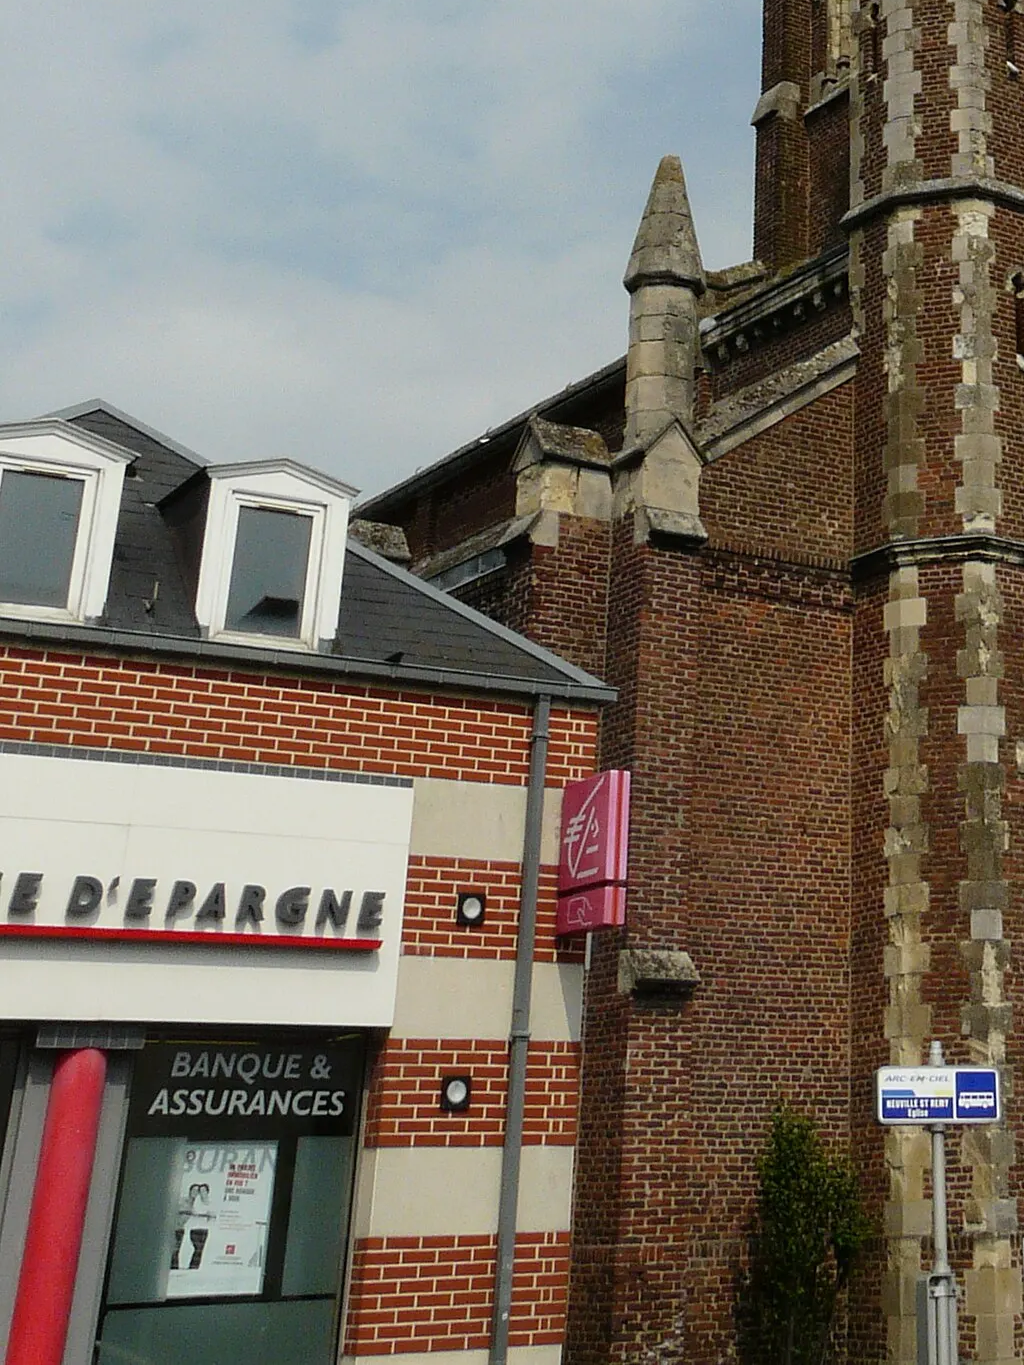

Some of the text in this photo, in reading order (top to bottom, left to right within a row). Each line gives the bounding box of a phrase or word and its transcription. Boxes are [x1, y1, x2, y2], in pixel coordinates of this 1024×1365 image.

[0, 872, 386, 930] E D'EPARGNE
[171, 1051, 332, 1085] BANQUE &
[148, 1088, 346, 1116] ASSURANCES
[886, 1099, 918, 1108] NEUVILLE
[920, 1099, 929, 1108] ST
